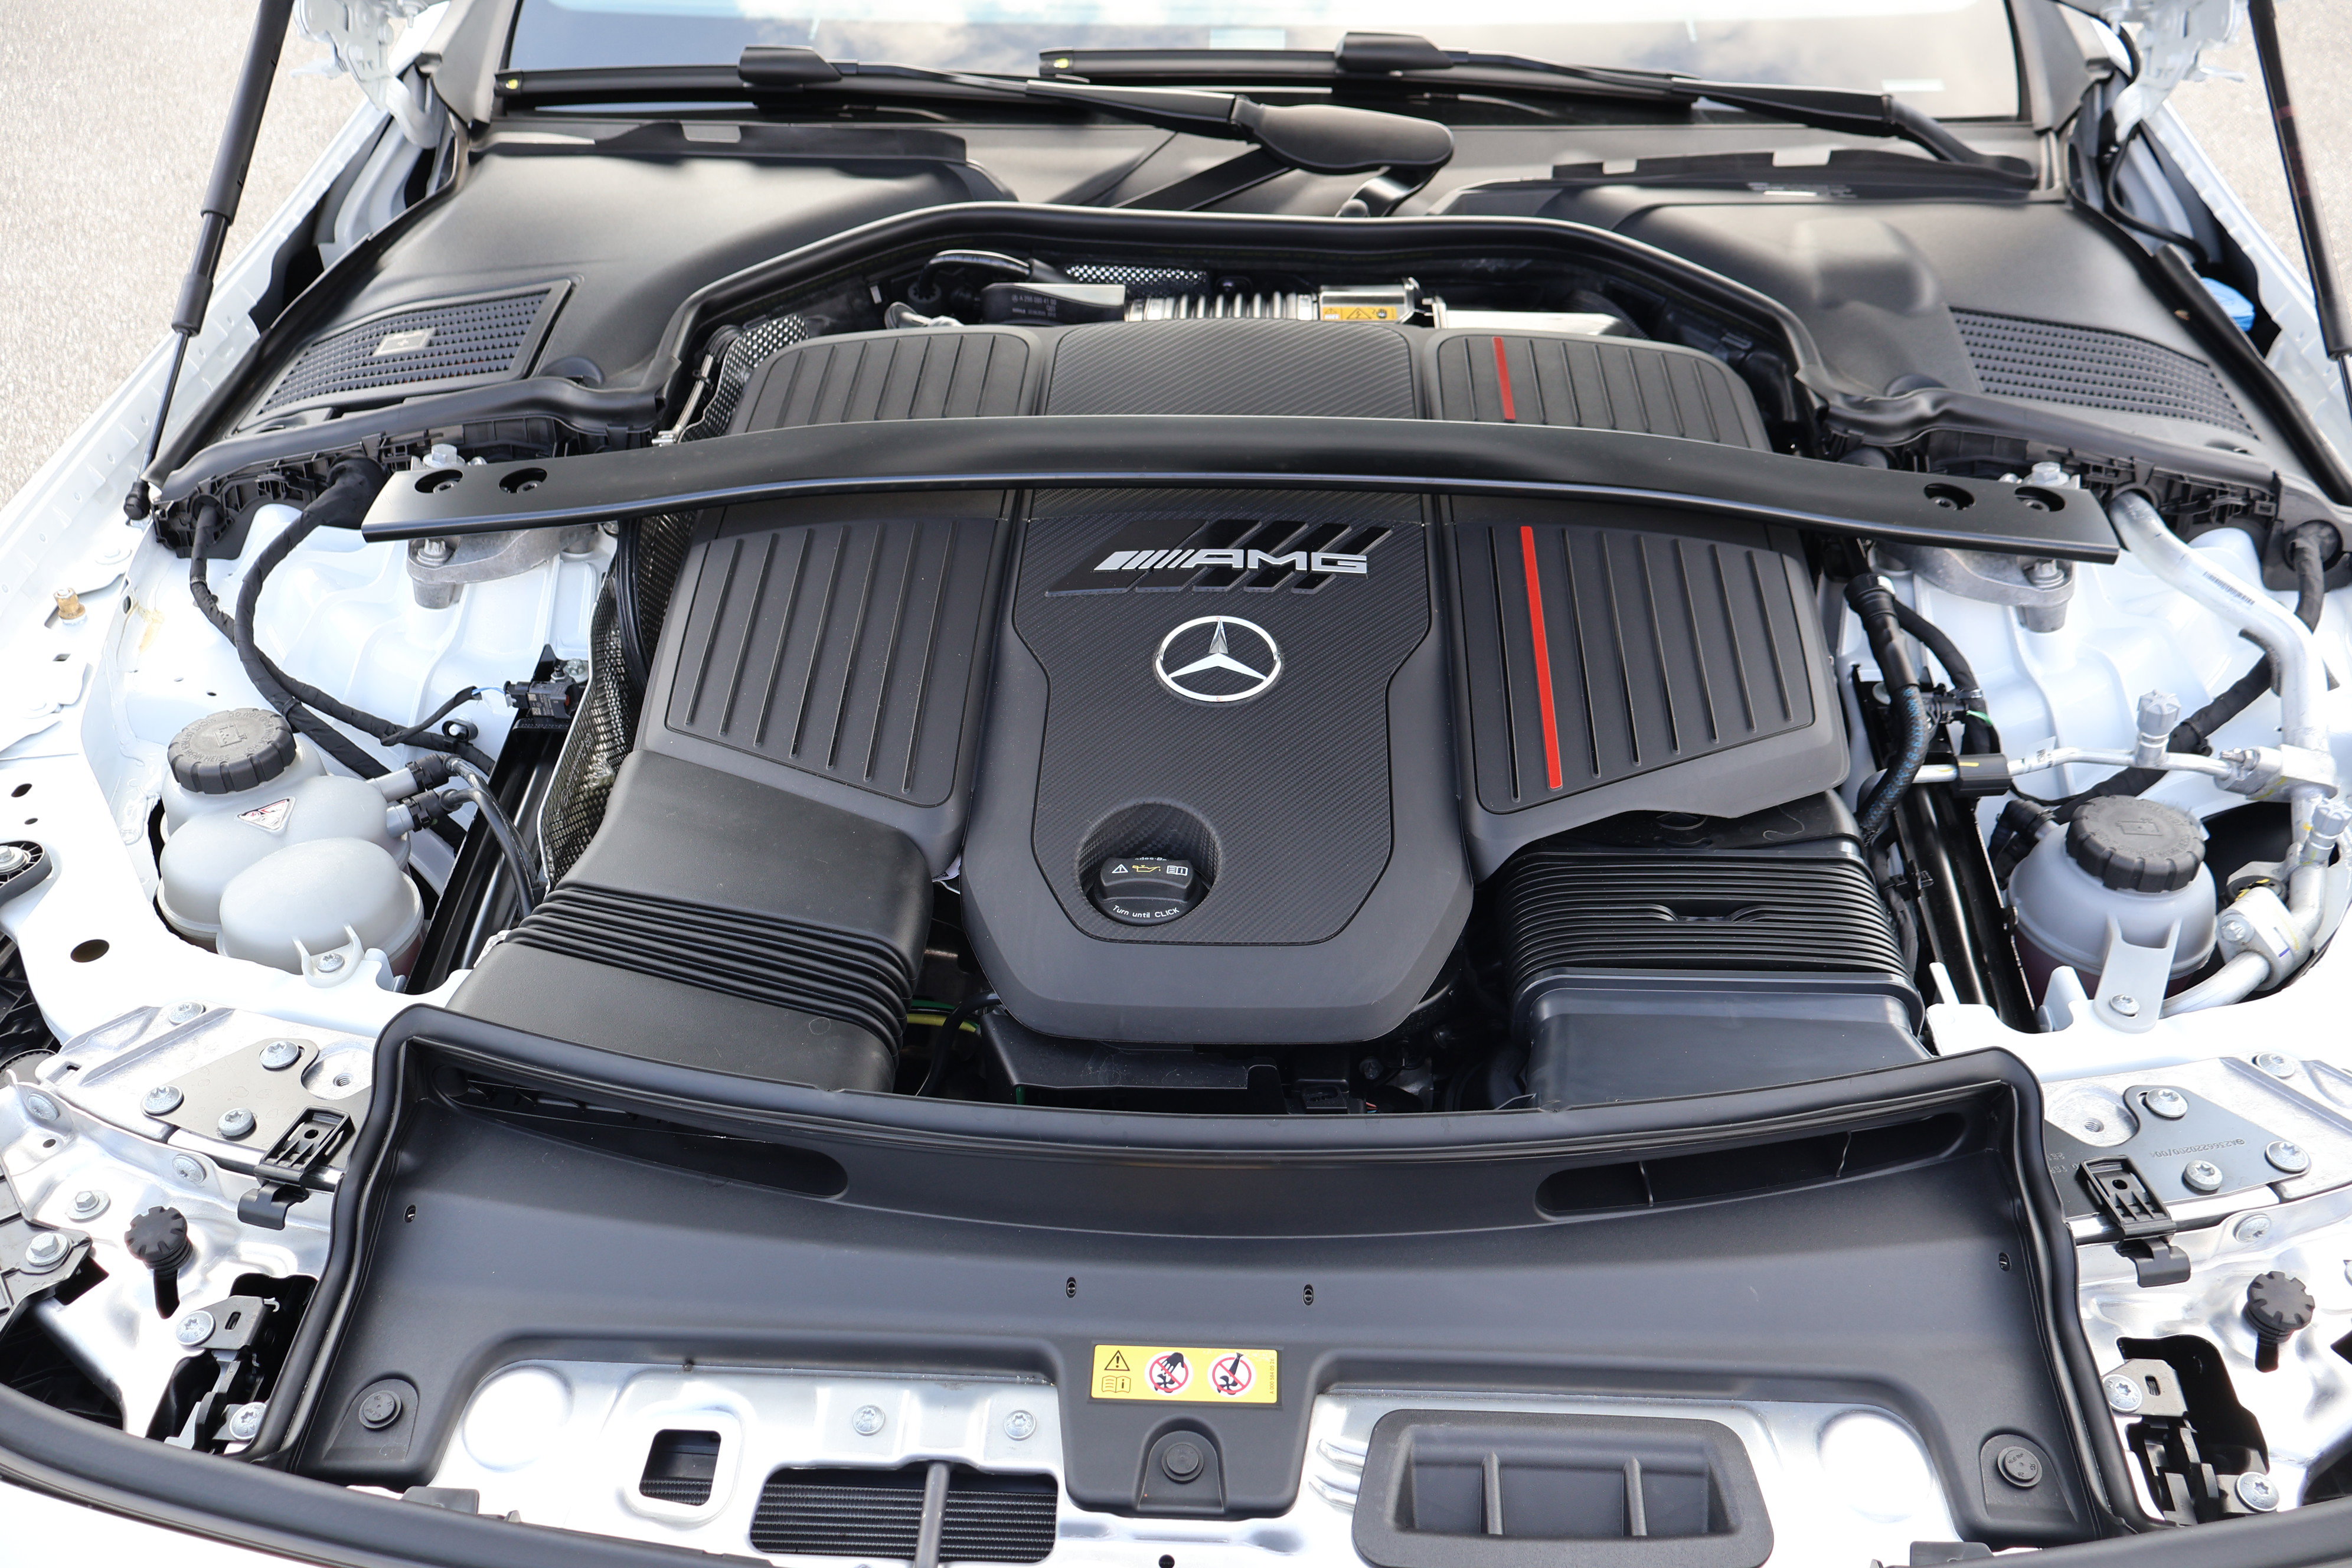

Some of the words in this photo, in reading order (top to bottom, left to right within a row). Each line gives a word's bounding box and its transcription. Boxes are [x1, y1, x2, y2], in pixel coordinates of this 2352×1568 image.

[1181, 548, 1367, 574] AMG
[1112, 905, 1129, 916] Turn
[1155, 907, 1180, 917] CLICK
